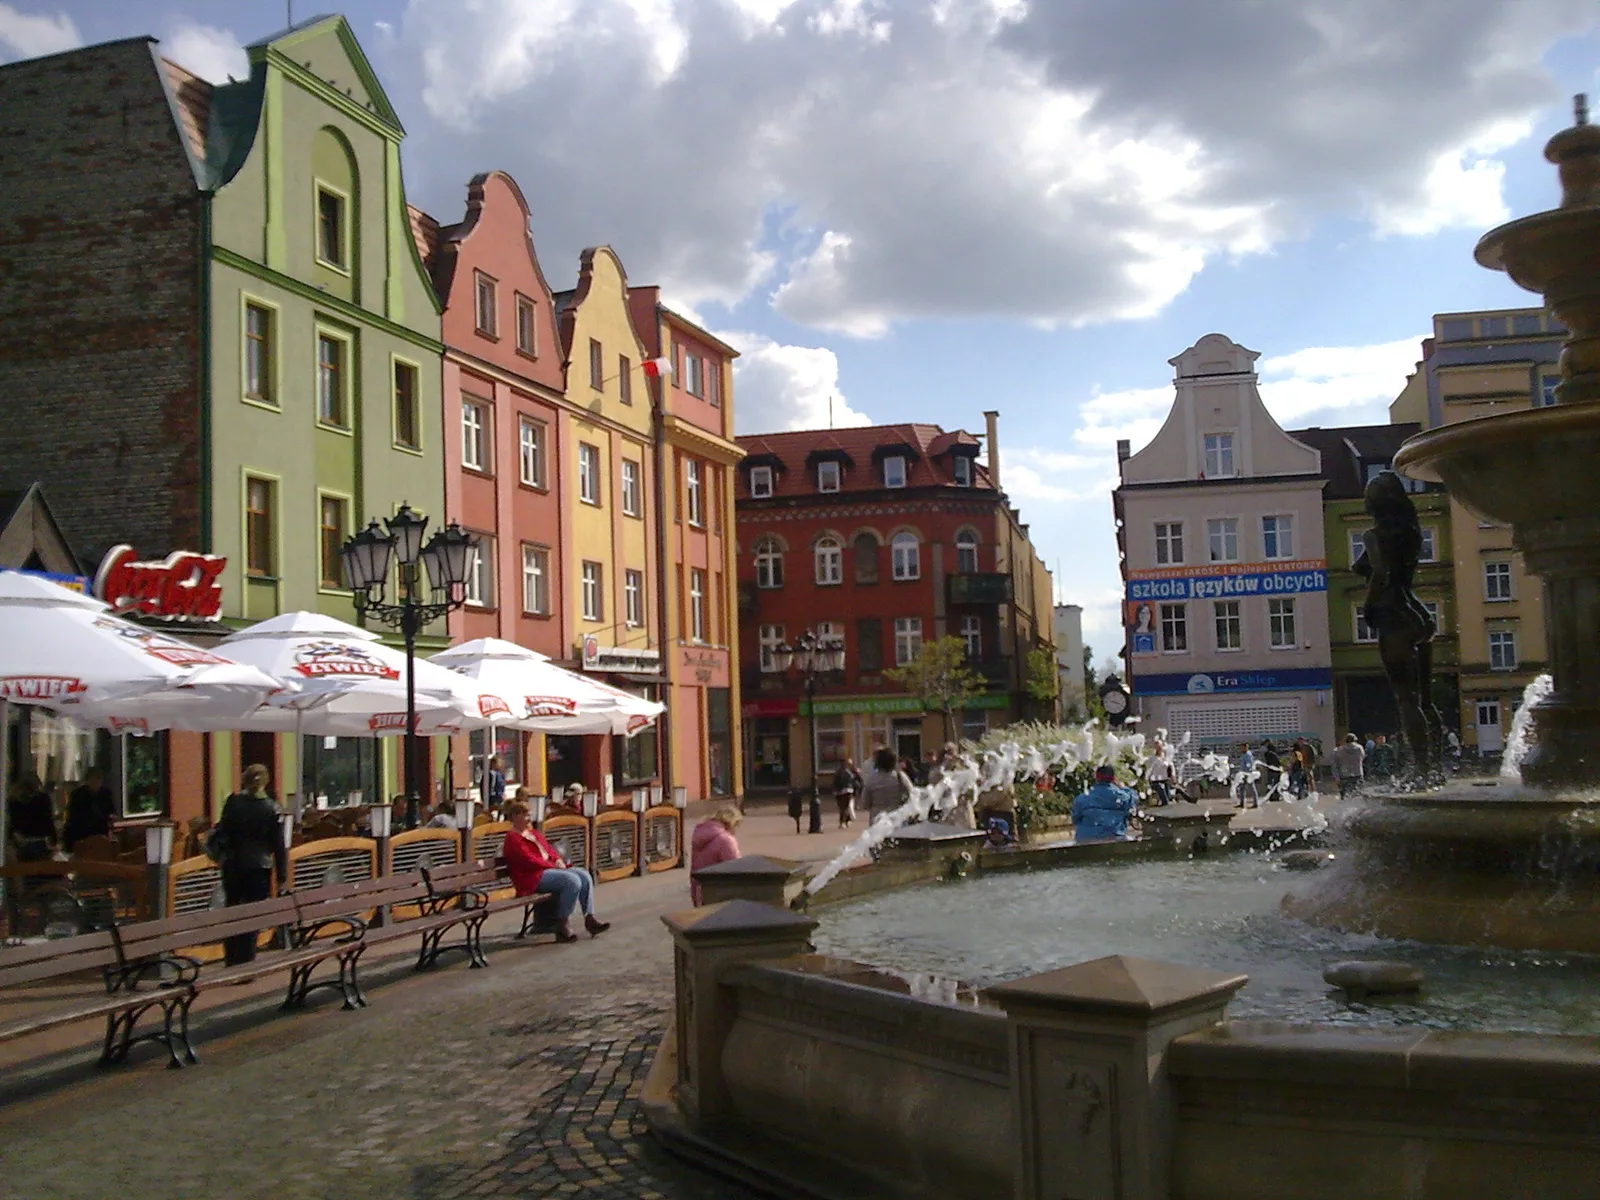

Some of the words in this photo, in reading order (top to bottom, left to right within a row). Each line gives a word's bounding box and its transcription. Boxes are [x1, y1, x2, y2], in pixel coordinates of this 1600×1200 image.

[1132, 579, 1186, 598] szkoła
[1189, 574, 1259, 598] języków
[1263, 571, 1324, 592] obcych
[1216, 675, 1238, 686] Era
